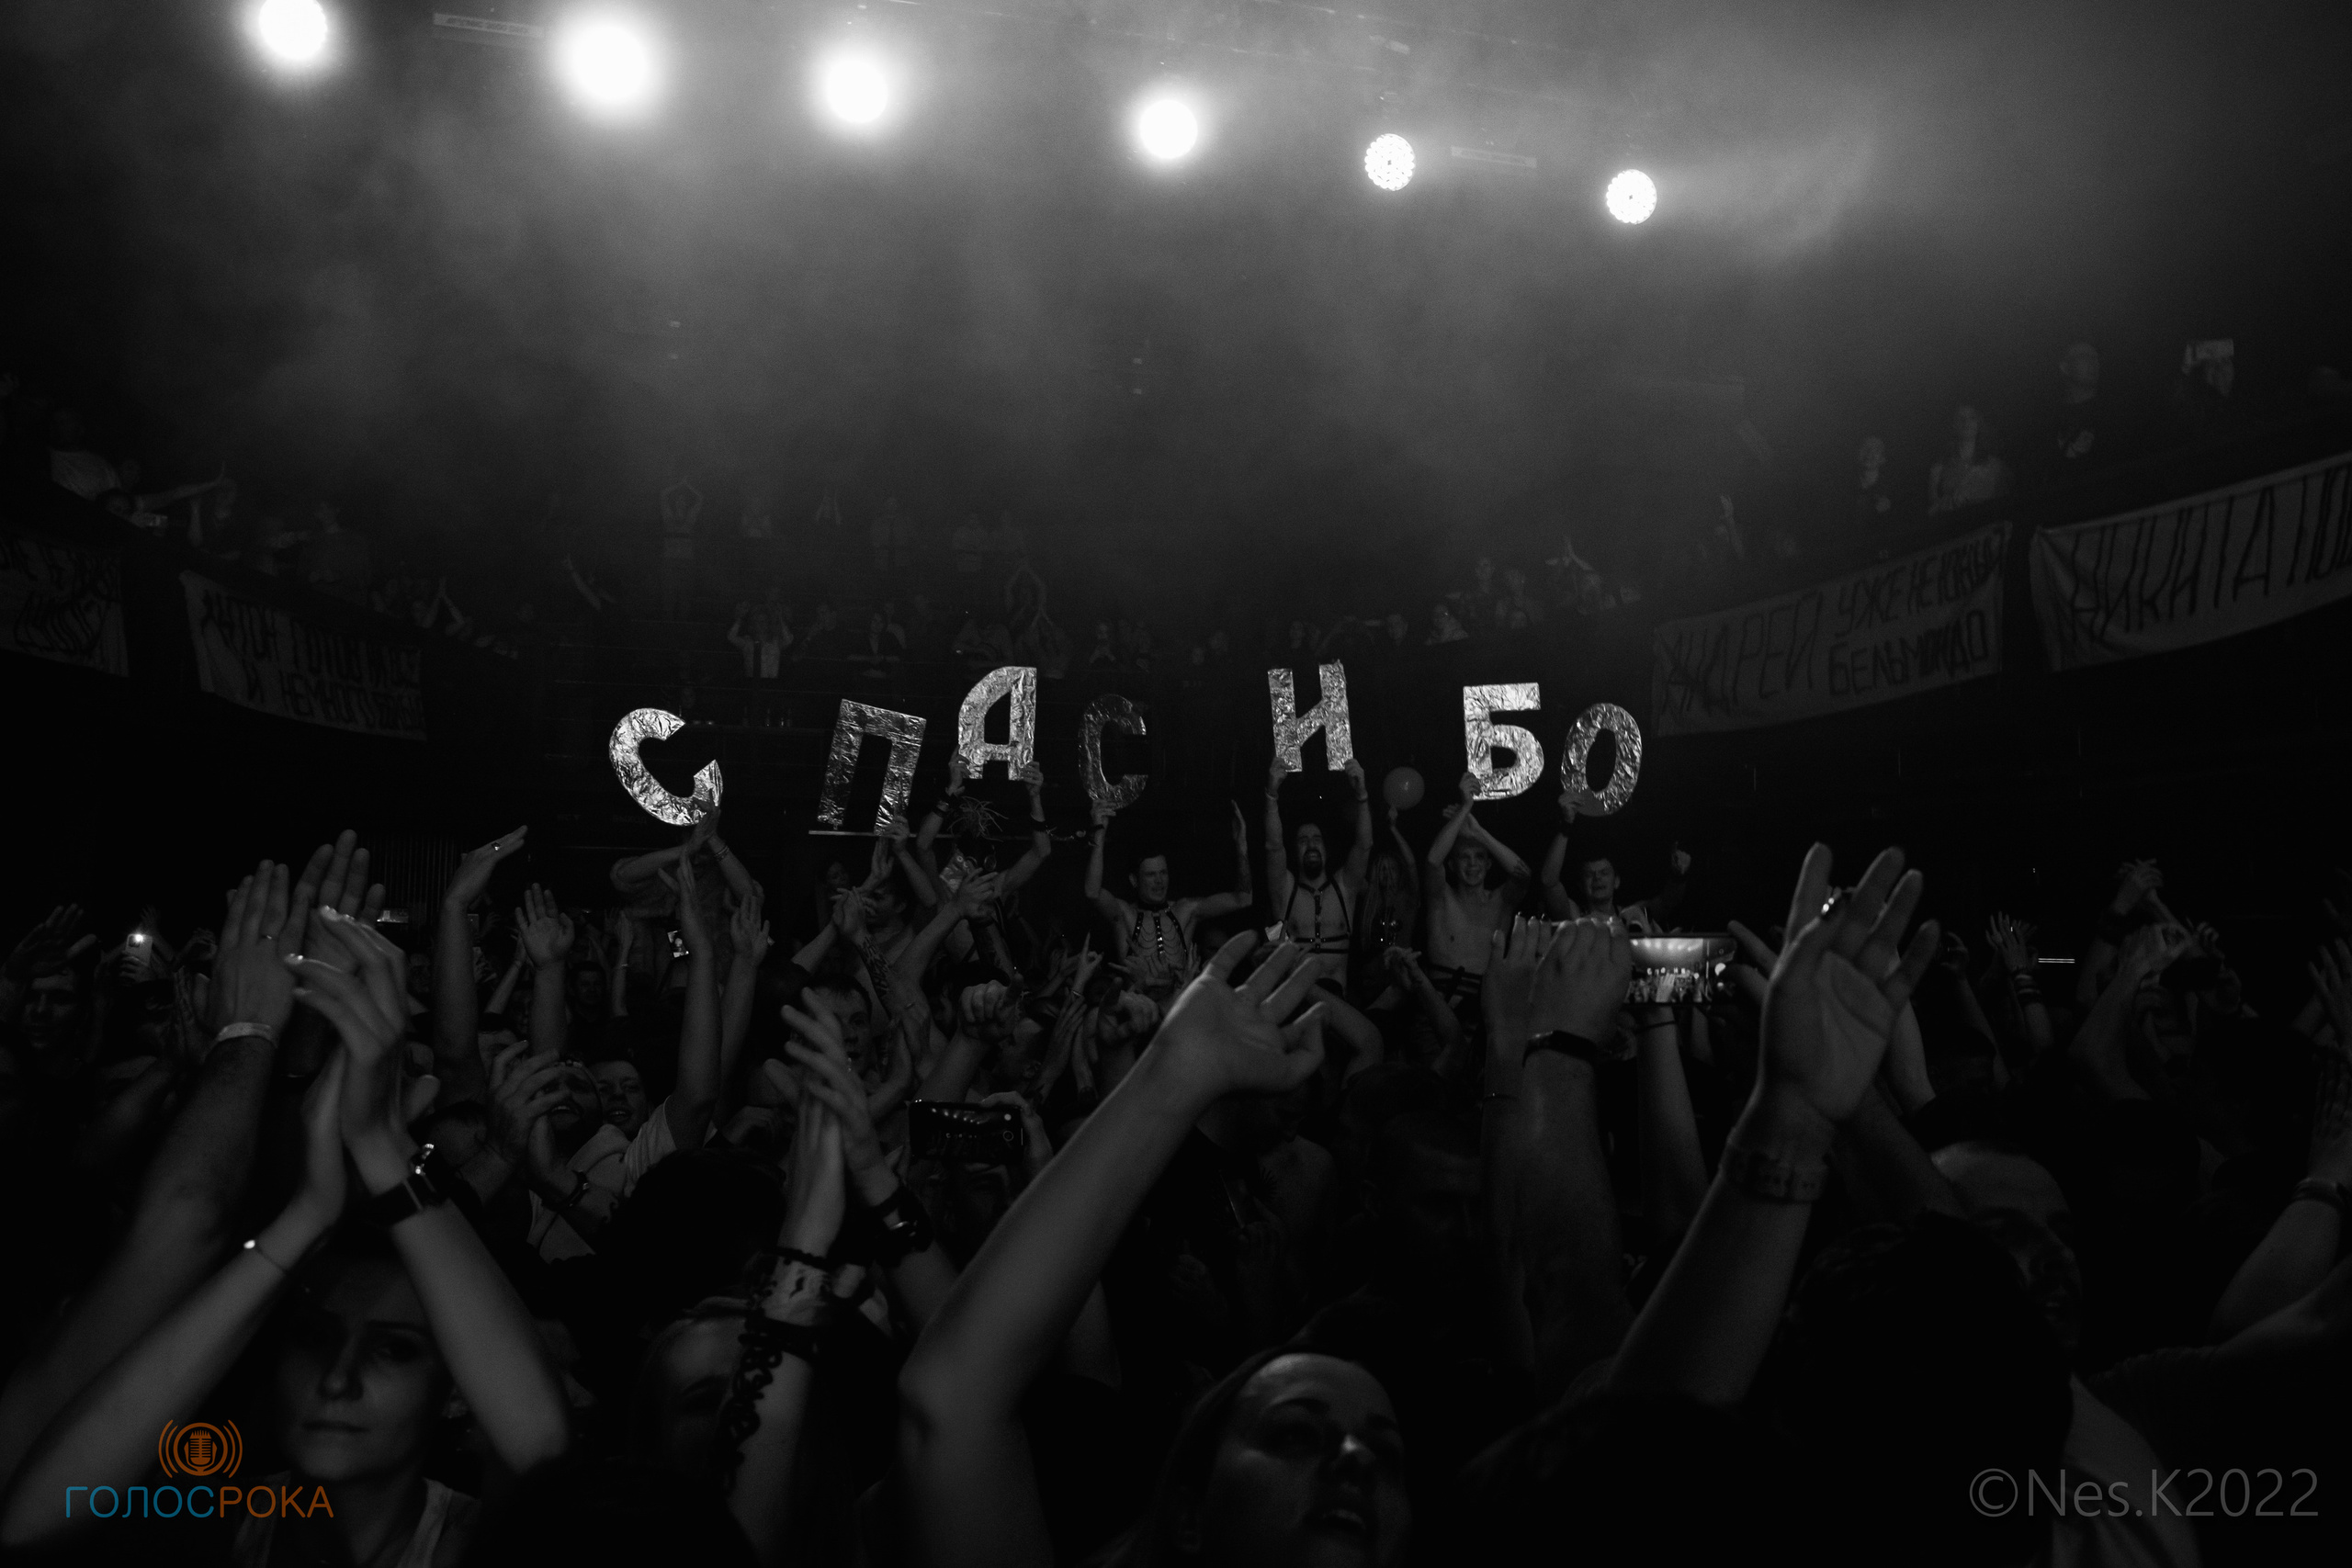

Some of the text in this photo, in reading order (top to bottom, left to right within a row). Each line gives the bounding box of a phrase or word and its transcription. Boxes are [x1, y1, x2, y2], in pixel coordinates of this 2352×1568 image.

[1834, 564, 1906, 637] УЖЕ
[1906, 555, 1938, 617] НЕ
[2069, 486, 2276, 643] НИКИТА
[200, 591, 280, 663] АНТОН
[291, 616, 363, 683] ГОТОВ
[1661, 589, 1824, 717] АНДРЕЙ
[1828, 608, 1989, 695] БЕЛЬМОНДО
[243, 657, 266, 705] И
[278, 670, 376, 728] НЕМНОГО
[609, 661, 1645, 839] СПАСИБО
